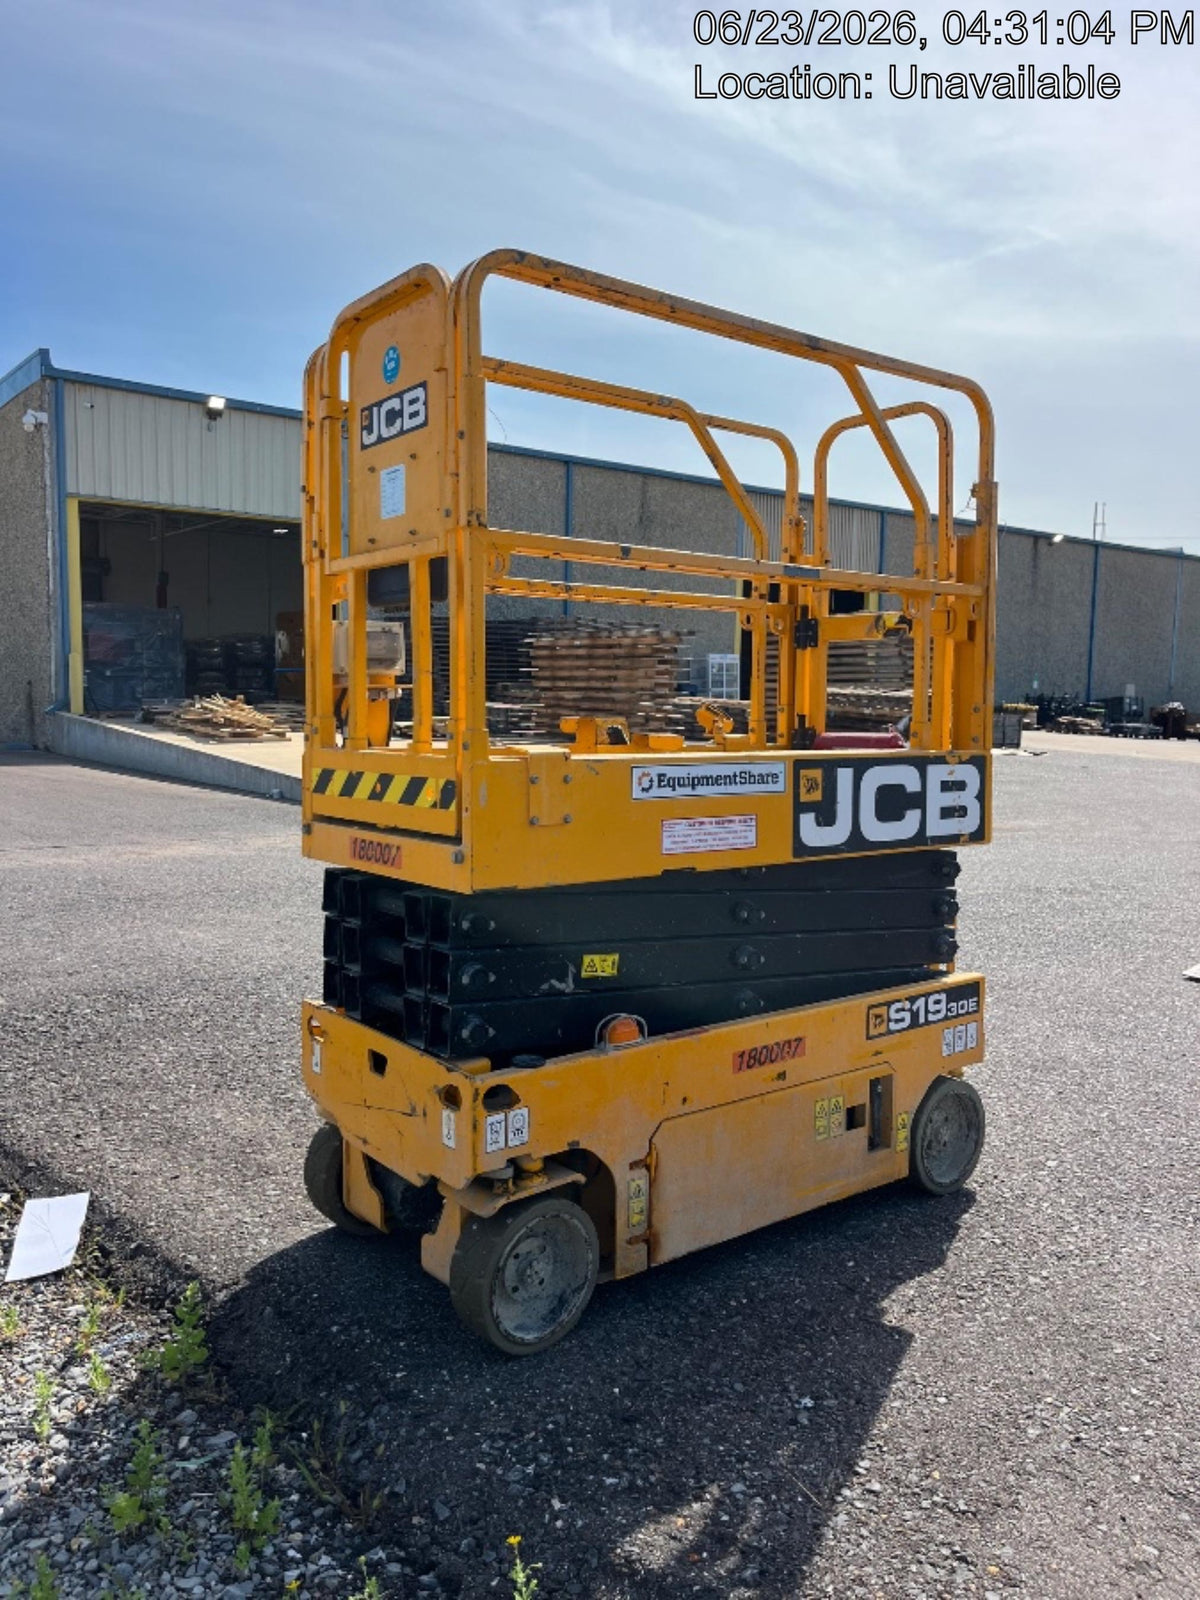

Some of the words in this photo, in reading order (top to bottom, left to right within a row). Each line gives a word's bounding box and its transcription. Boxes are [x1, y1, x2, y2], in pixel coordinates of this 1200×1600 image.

[361, 386, 427, 446] JCB
[656, 770, 780, 792] EquipmentShare
[799, 764, 981, 848] JCB
[352, 837, 401, 867] 180007
